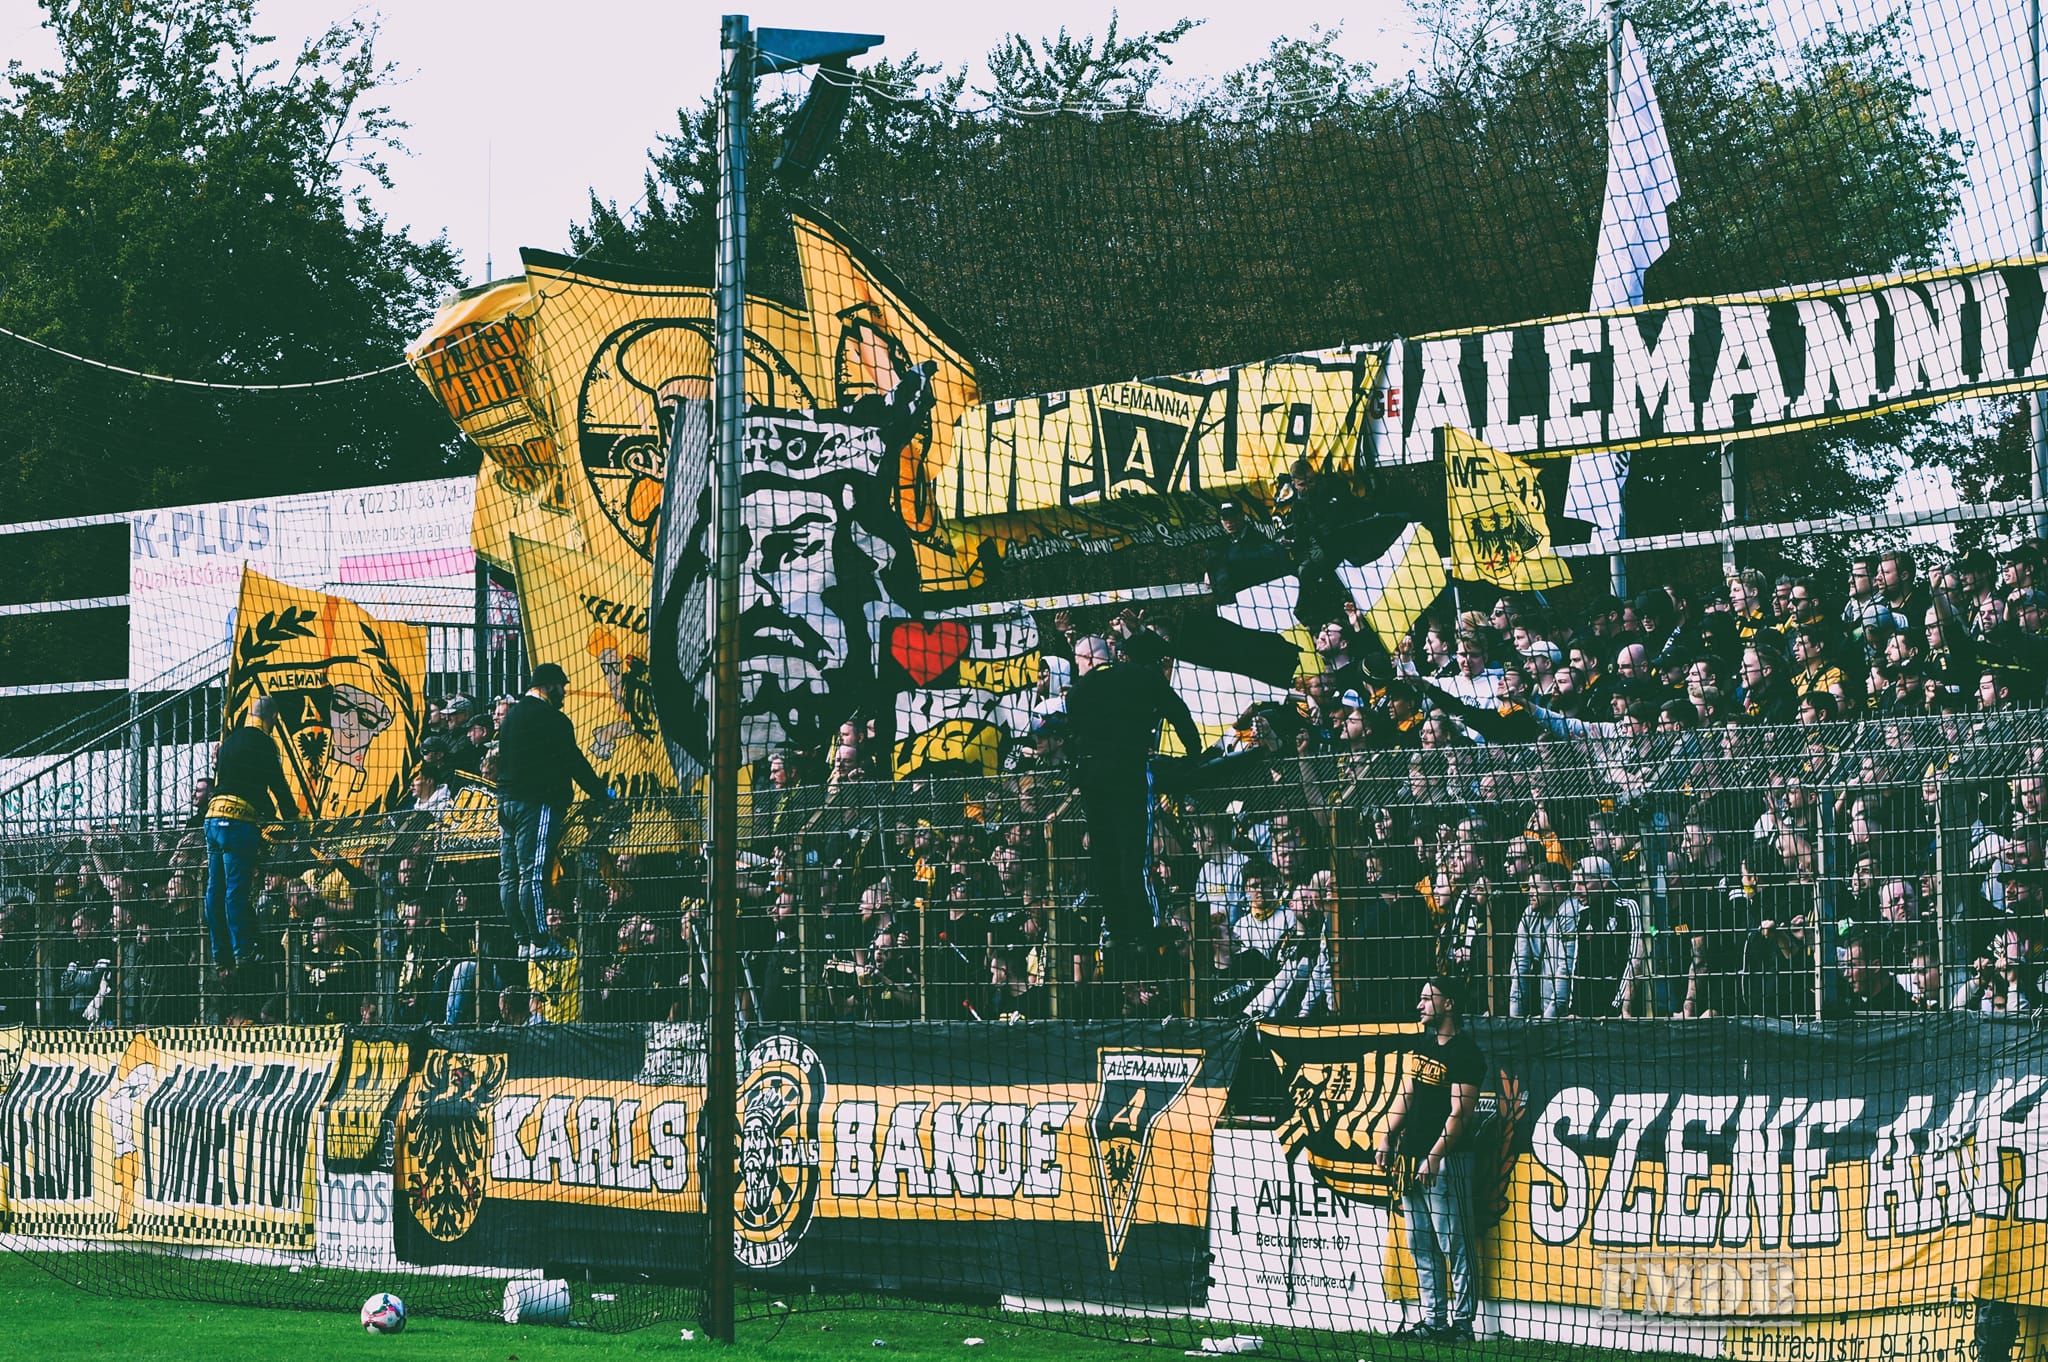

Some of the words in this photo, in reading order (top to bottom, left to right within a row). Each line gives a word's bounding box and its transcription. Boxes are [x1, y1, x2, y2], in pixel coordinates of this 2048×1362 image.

[1099, 383, 1190, 421] ALEMANNIA
[1123, 426, 1156, 478] A
[133, 503, 270, 560] K-PLUS
[580, 593, 650, 634] YELLO
[749, 1038, 815, 1074] KARLS
[1106, 1058, 1190, 1080] ALEMANNIA
[142, 1061, 333, 1211] CONNECTION
[490, 1094, 689, 1193] KARLS
[831, 1099, 1078, 1199] BANDE
[1529, 1085, 1866, 1250] SZENE
[1255, 1179, 1350, 1219] AHLEN
[319, 1241, 343, 1263] aus
[349, 1236, 384, 1265] einer
[1331, 1235, 1351, 1252] 107
[1255, 1273, 1354, 1289] www.auto-funke.d
